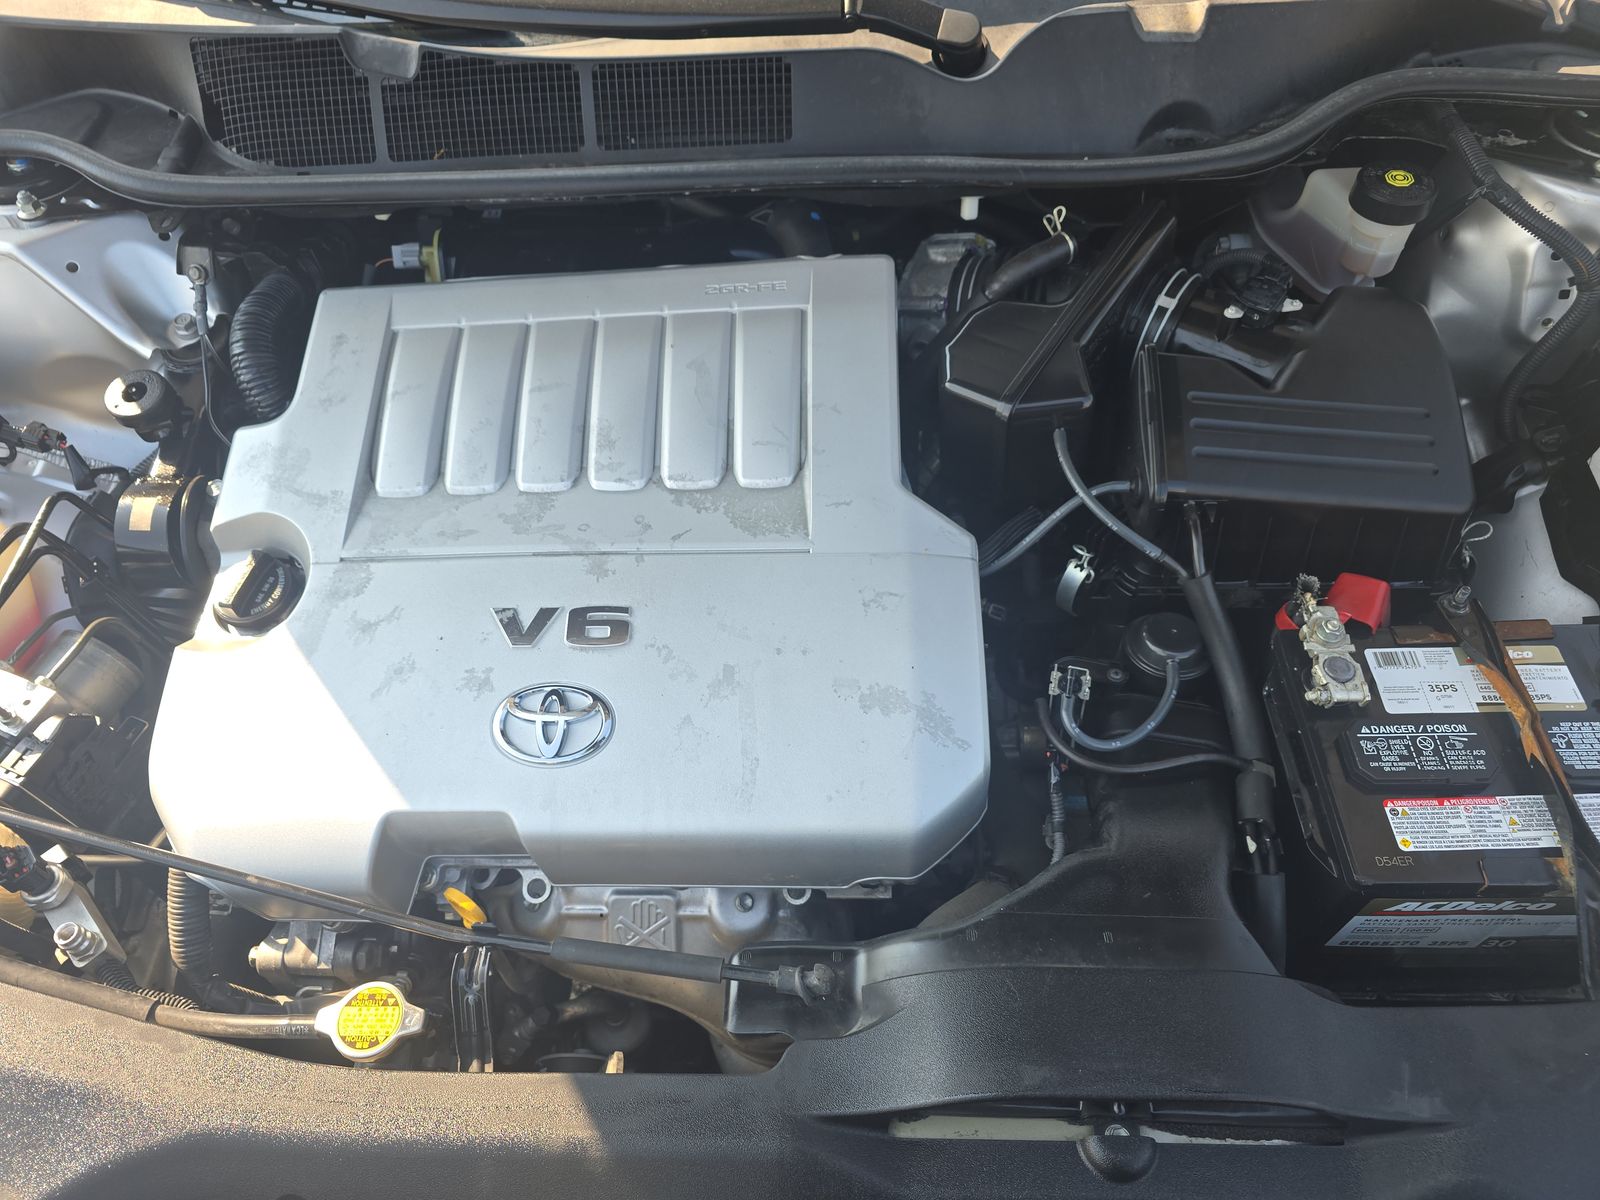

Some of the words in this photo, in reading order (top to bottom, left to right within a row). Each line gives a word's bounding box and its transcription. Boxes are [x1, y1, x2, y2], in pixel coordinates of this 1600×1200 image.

[704, 280, 788, 295] 2GR-FE
[490, 605, 631, 648] V6
[1371, 725, 1416, 733] DANGER
[1426, 724, 1467, 733] POISON
[1384, 901, 1557, 911] ACDelco
[1481, 939, 1518, 948] 30
